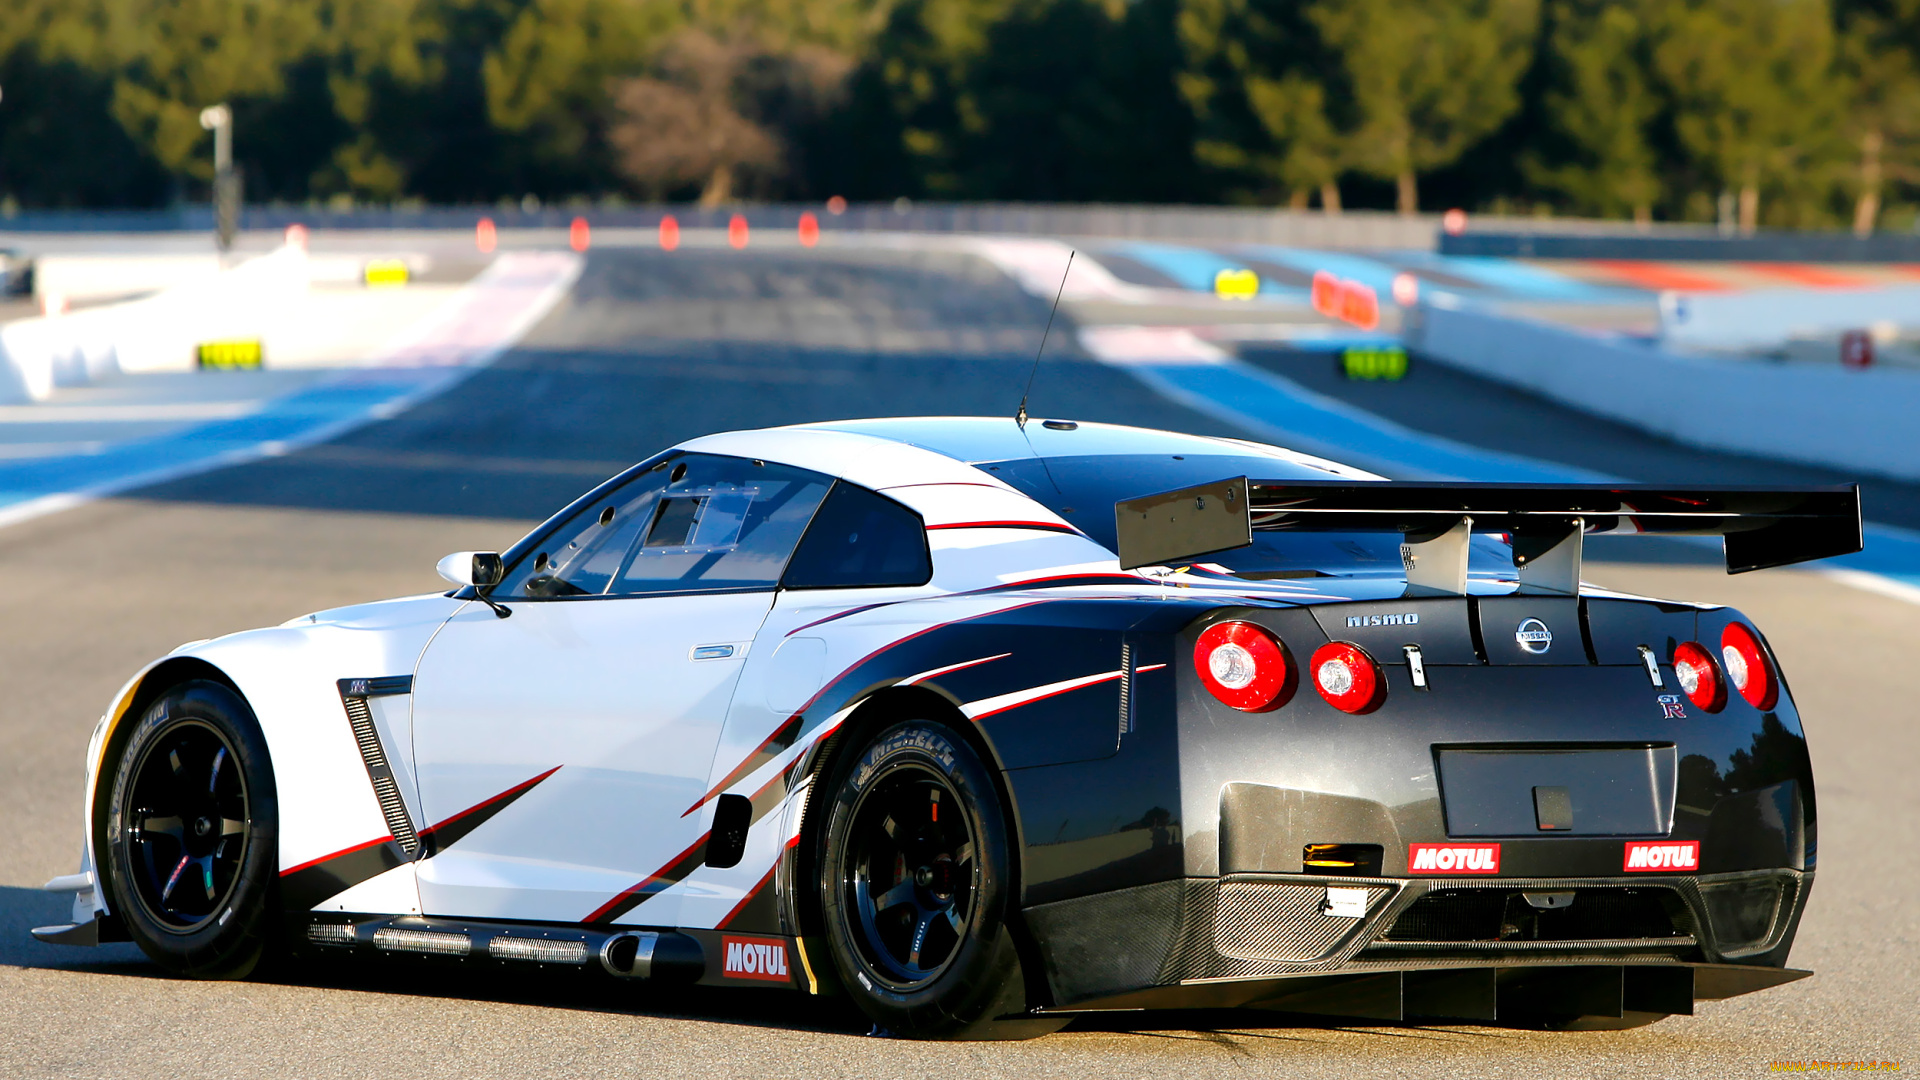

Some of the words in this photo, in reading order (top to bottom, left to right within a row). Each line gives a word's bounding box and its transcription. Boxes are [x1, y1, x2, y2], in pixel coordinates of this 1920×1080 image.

[1520, 632, 1551, 640] NISSAN
[1412, 847, 1496, 871] MOTUL
[1627, 845, 1696, 868] MOTUL
[725, 942, 787, 976] MOTUL
